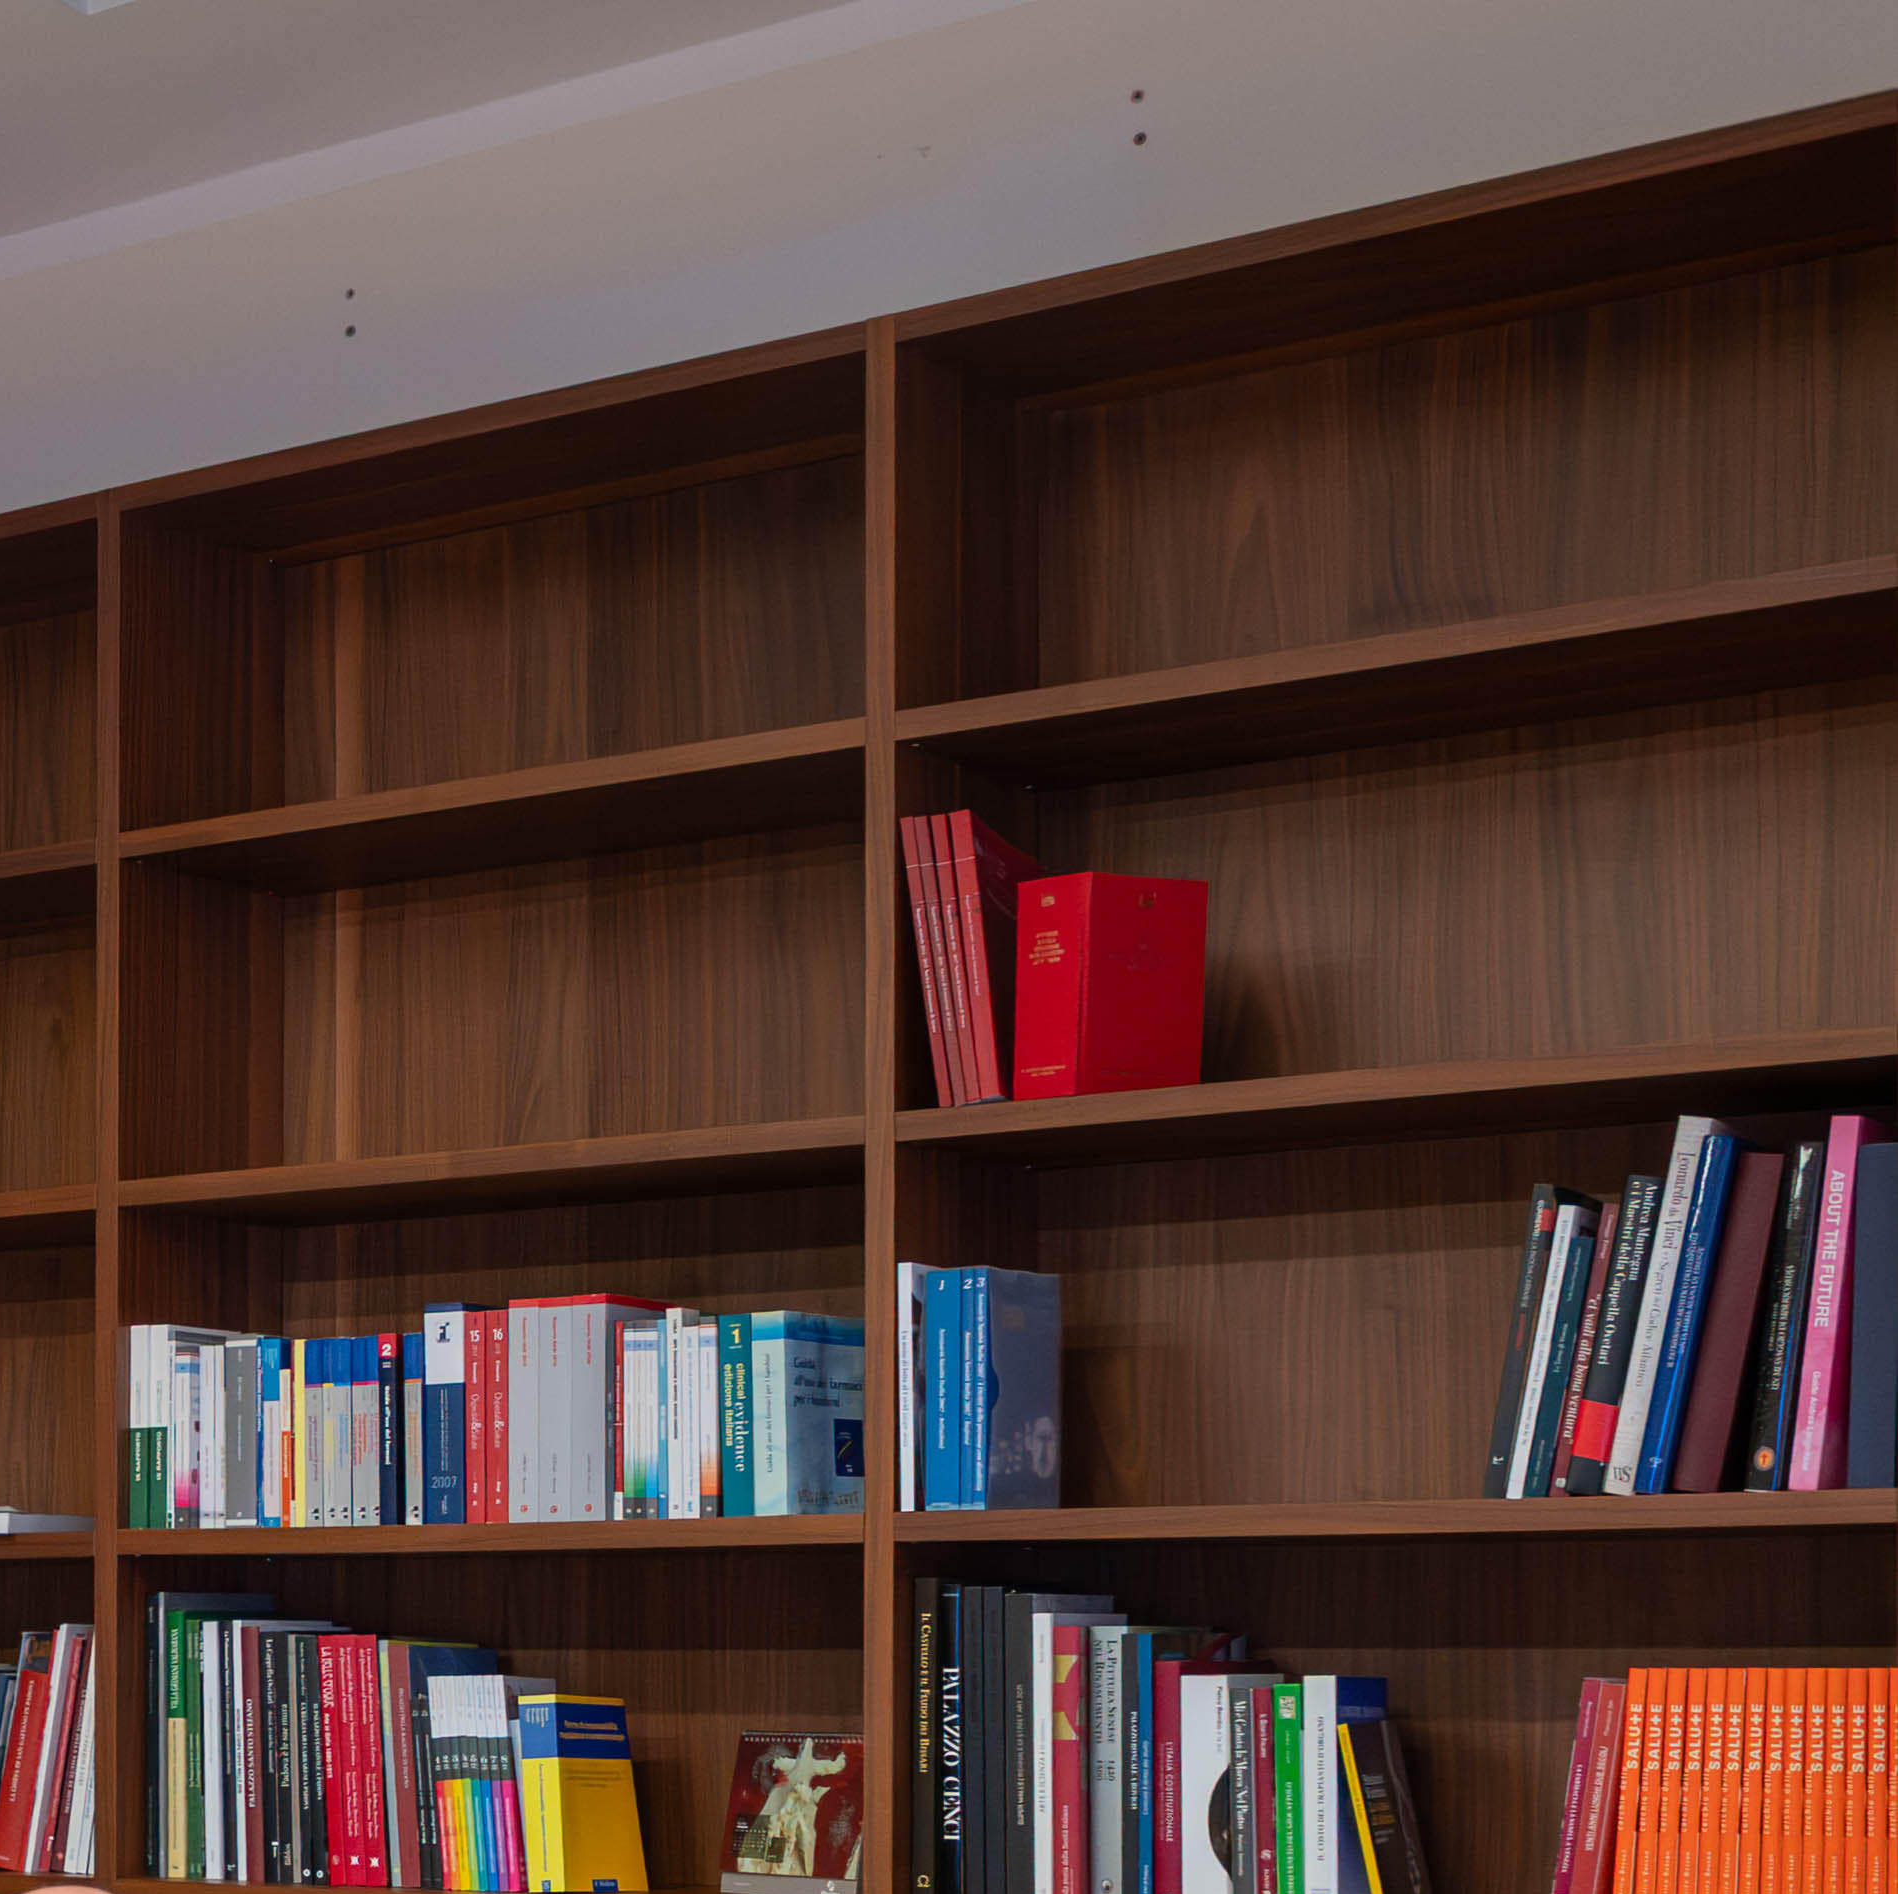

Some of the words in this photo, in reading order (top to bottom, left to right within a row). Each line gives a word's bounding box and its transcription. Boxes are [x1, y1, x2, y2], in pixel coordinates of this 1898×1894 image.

[1670, 1152, 1697, 1206] Leonardo
[1825, 1169, 1846, 1224] ABOUT
[1619, 1196, 1639, 1239] Maestri
[1636, 1182, 1658, 1223] Andrea
[1627, 1225, 1652, 1281] Mantegna
[1661, 1219, 1683, 1249] Vinci
[1821, 1228, 1839, 1259] THE
[1615, 1241, 1633, 1269] della
[1604, 1272, 1627, 1321] Cappella
[1813, 1263, 1836, 1328] FUTURE
[469, 1329, 481, 1342] 15
[492, 1328, 504, 1341] 16
[1580, 1312, 1599, 1338] vadi
[381, 1343, 392, 1357] 2
[1576, 1340, 1594, 1361] alla
[1596, 1323, 1617, 1366] Ovetari
[723, 1363, 734, 1407] edizione
[735, 1363, 747, 1400] clinical
[1571, 1363, 1590, 1392] bona
[725, 1409, 735, 1447] italiana
[733, 1402, 749, 1472] evidence
[430, 1475, 457, 1490] 2007
[265, 1648, 275, 1676] Cappella
[919, 1624, 932, 1668] CASTELLO
[1094, 1640, 1105, 1658] NEL
[1106, 1640, 1118, 1653] LA
[265, 1678, 275, 1705] Ovetari
[1106, 1657, 1118, 1703] PITTURA
[245, 1697, 254, 1735] STEFANO
[942, 1666, 961, 1767] PALAZZO
[1094, 1661, 1105, 1744] RINASCIMENTO
[1106, 1706, 1118, 1744] SENESE
[246, 1737, 255, 1765] SANTO
[1165, 1741, 1174, 1772] L'ITALIA
[247, 1767, 256, 1808] PALAZZO
[942, 1775, 961, 1841] CENCI
[1165, 1774, 1174, 1842] COSTITUZIONALE
